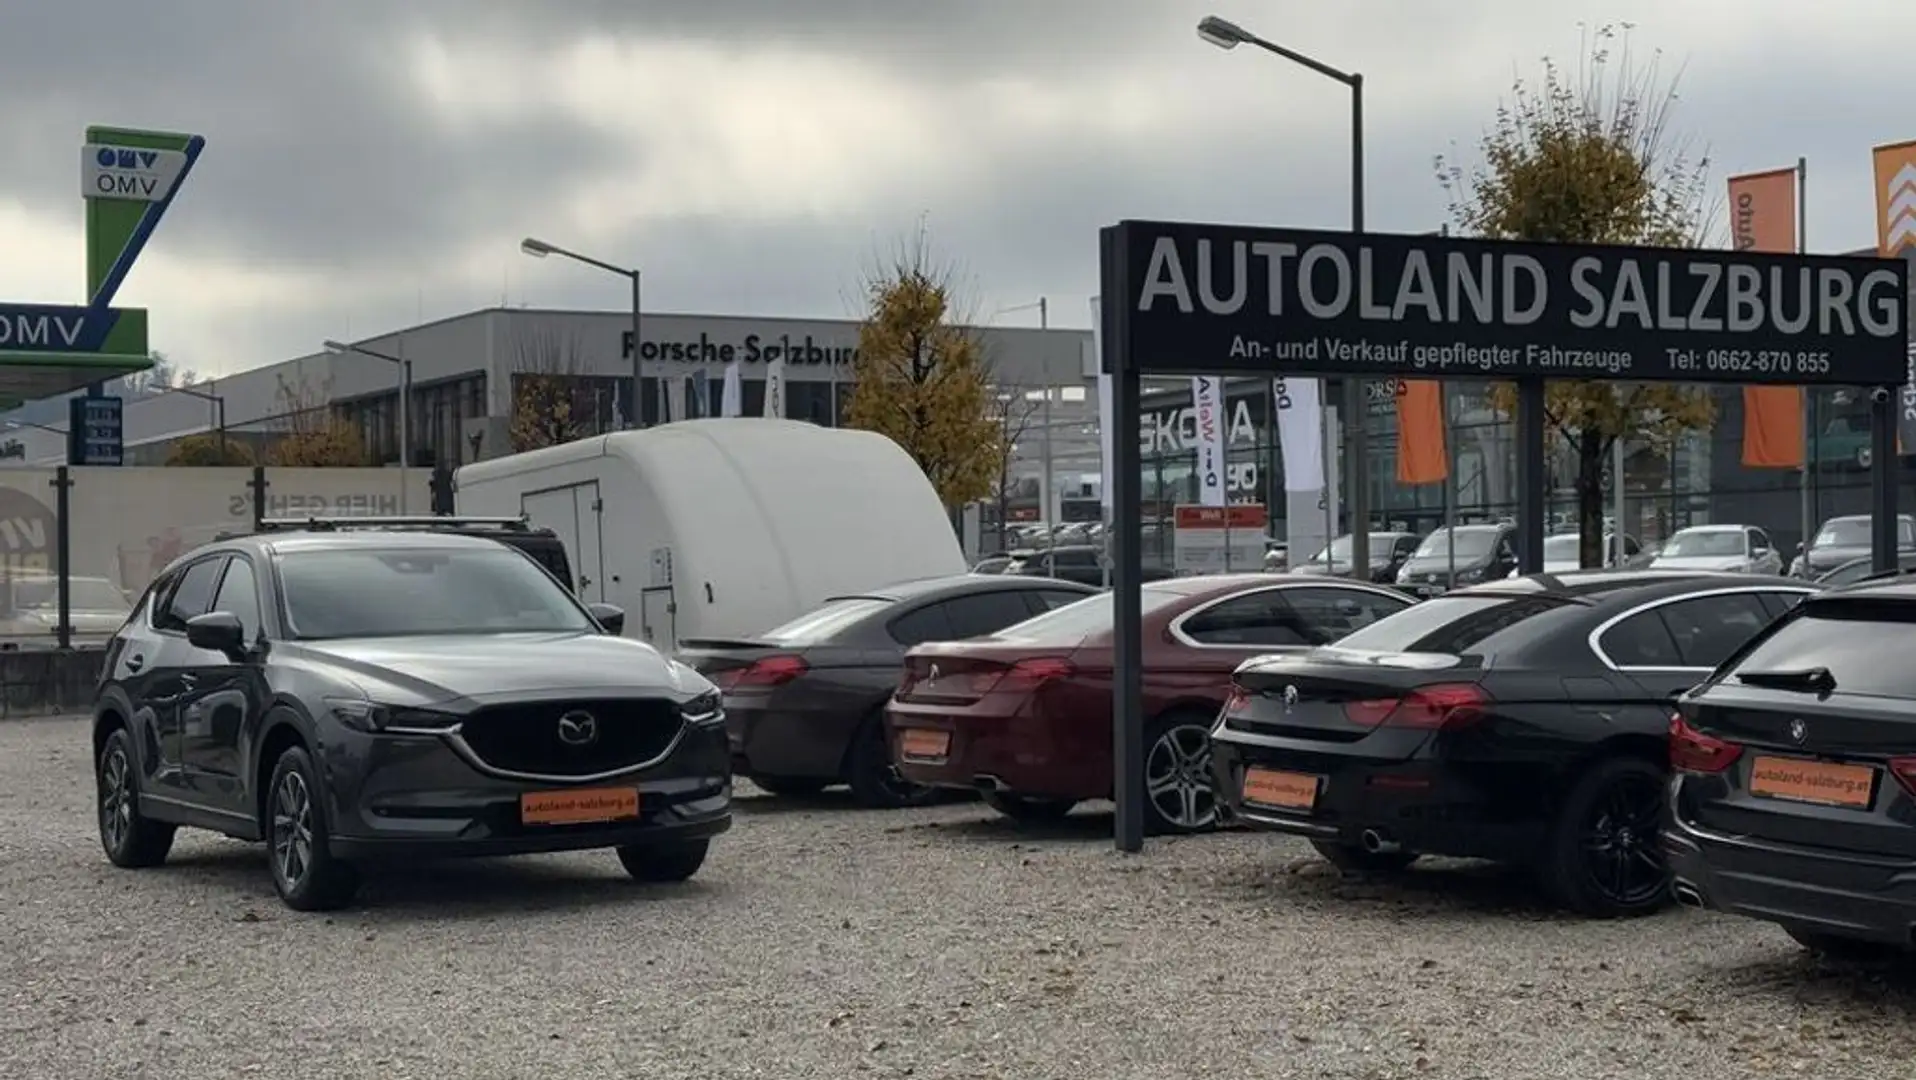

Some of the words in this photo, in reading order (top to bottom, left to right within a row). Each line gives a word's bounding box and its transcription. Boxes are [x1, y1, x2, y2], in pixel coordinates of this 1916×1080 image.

[97, 147, 157, 168] OMV
[97, 174, 157, 194] OMV
[1138, 236, 1548, 325] AUTOLAND
[1570, 256, 1900, 337] SALZBURG
[0, 315, 85, 346] OMV
[622, 331, 735, 362] Porsche
[1230, 334, 1270, 359] An-
[1277, 337, 1319, 361] und
[1325, 338, 1409, 363] Verkauf
[1413, 342, 1519, 373] gepflegter
[1526, 345, 1633, 373] Fahrzeuge
[1666, 348, 1701, 370] Tel:
[1706, 351, 1791, 372] 0662-870
[1796, 353, 1831, 374] 855
[1139, 400, 1256, 453] SKOA
[1753, 768, 1868, 793] autoland-salzburg.at
